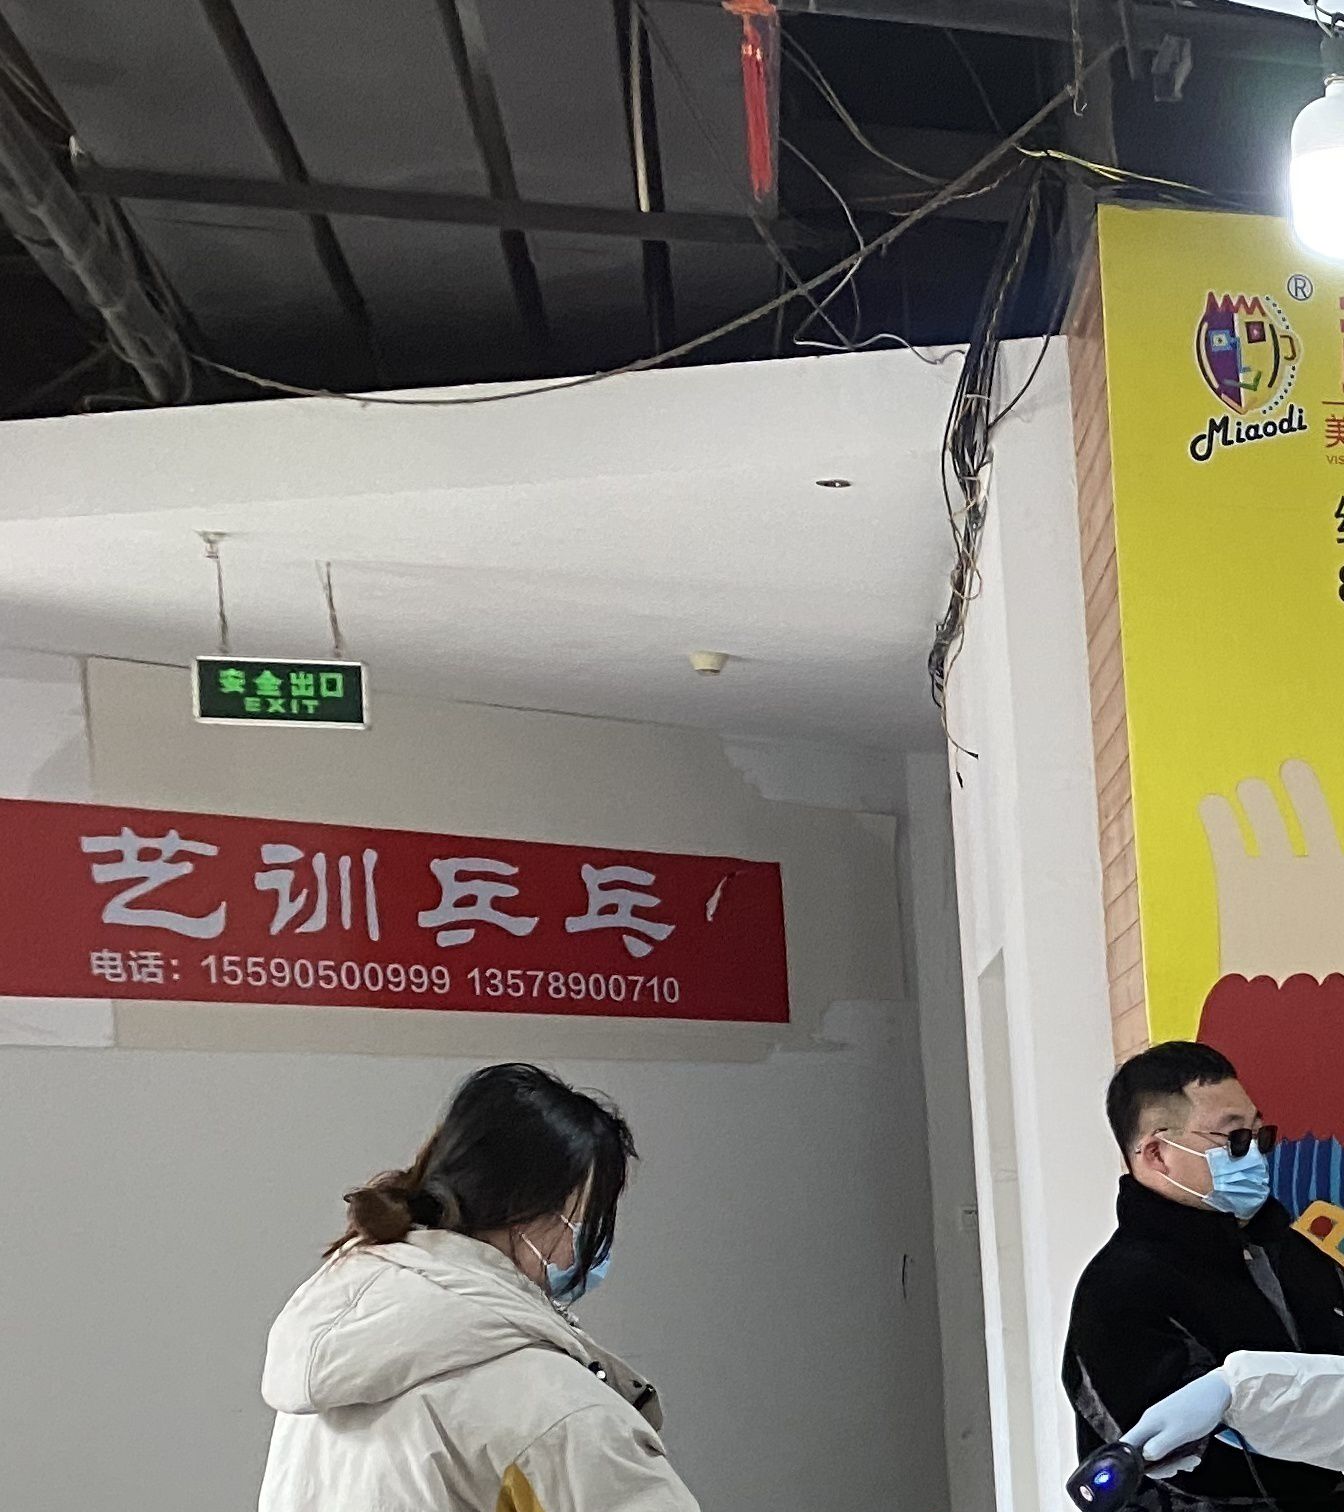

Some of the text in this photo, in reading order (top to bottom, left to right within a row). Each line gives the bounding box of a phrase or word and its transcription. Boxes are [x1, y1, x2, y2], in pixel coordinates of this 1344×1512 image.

[1189, 403, 1308, 462] Miaodi
[218, 668, 344, 698] 安全出口
[244, 697, 320, 714] EXIT
[80, 825, 678, 959] 艺训乒乓
[202, 955, 451, 996] 15590500999
[466, 965, 680, 1006] 13578900710
